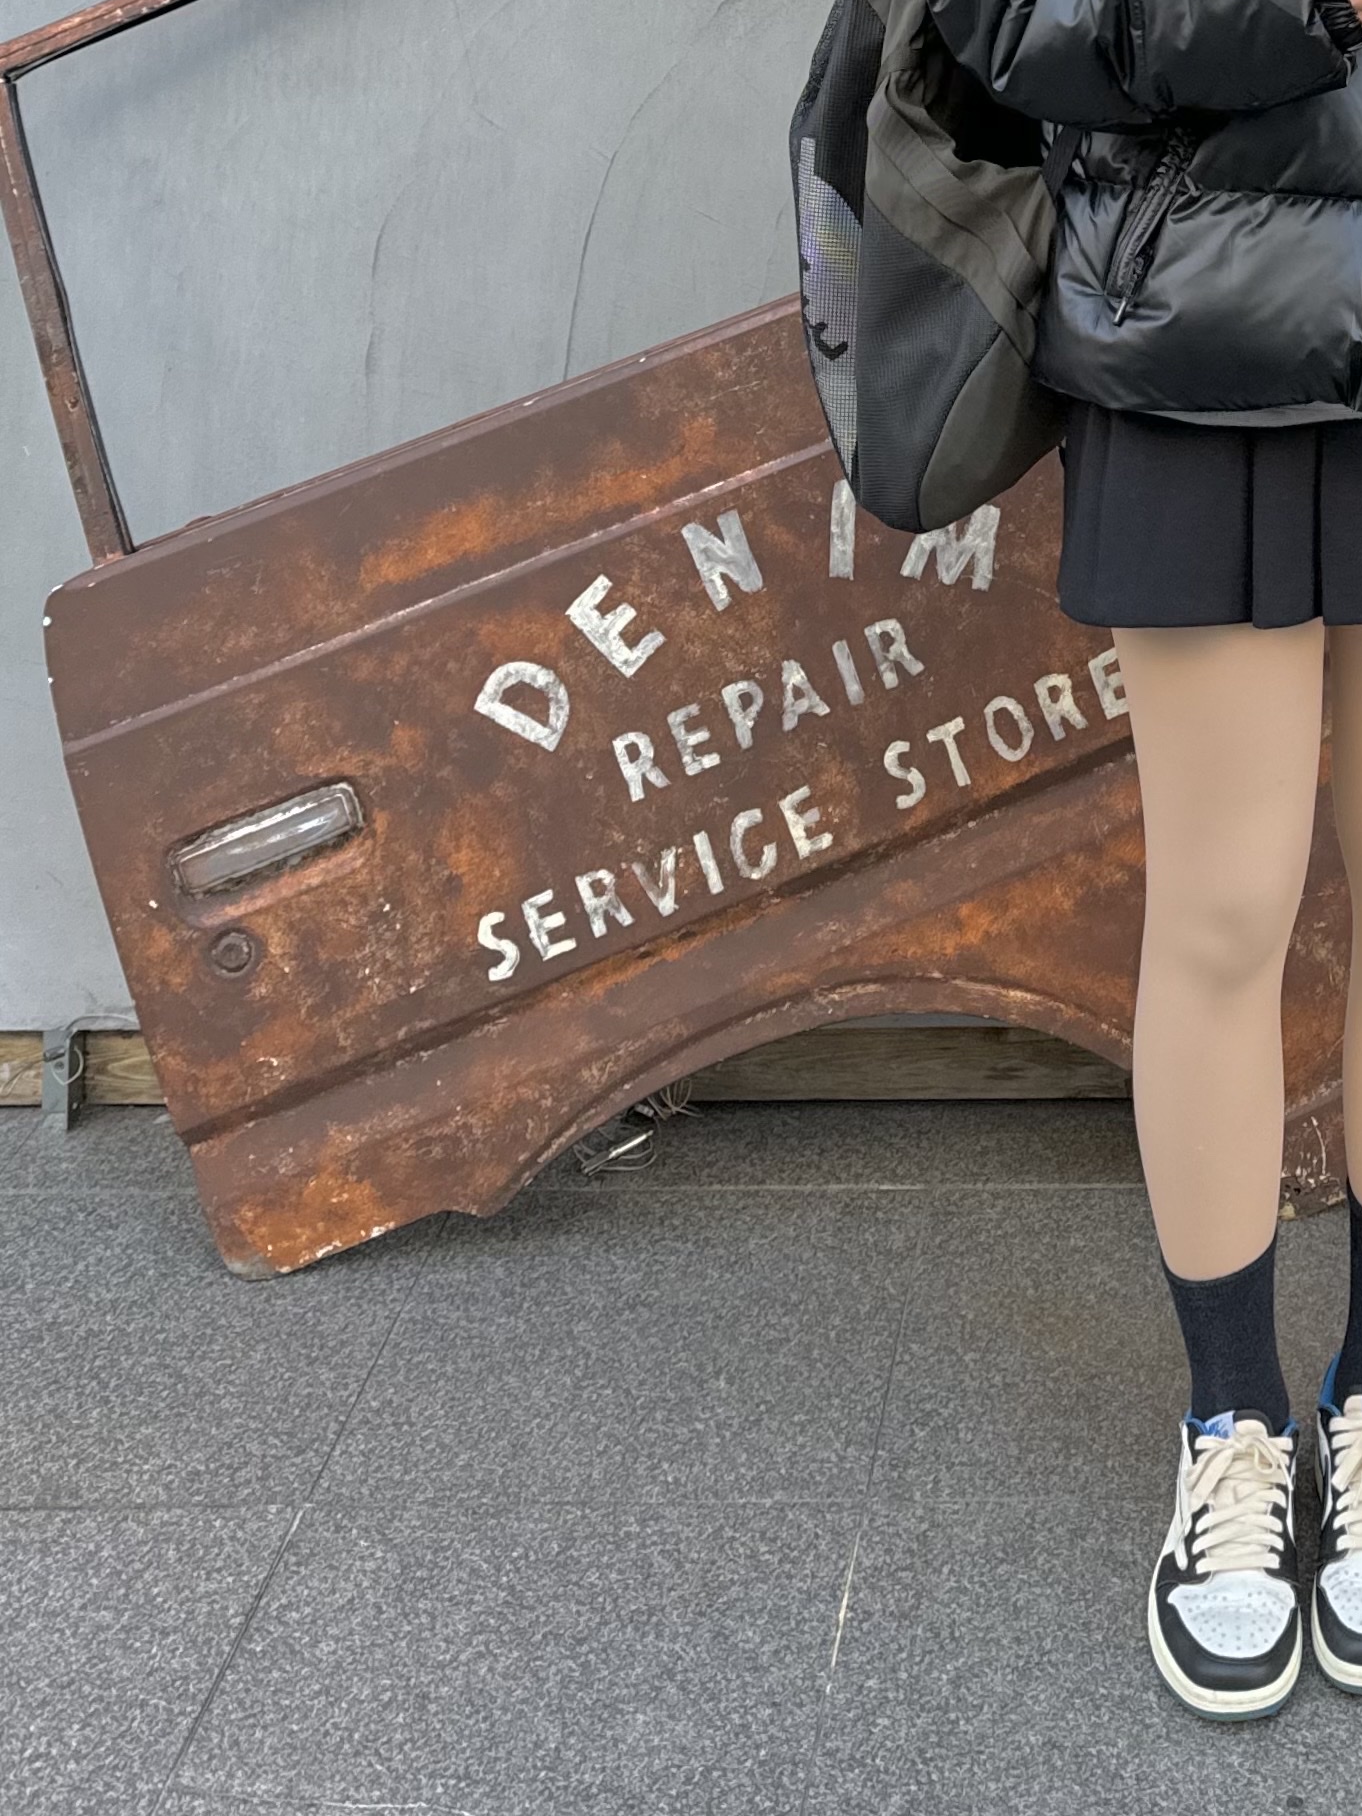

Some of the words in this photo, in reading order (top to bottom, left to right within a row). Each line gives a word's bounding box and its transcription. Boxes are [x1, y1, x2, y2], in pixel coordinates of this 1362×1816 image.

[474, 479, 1001, 753] DENIM
[612, 618, 925, 803] REPAIR
[477, 784, 834, 982] SERVICE
[882, 646, 1130, 810] STORE
